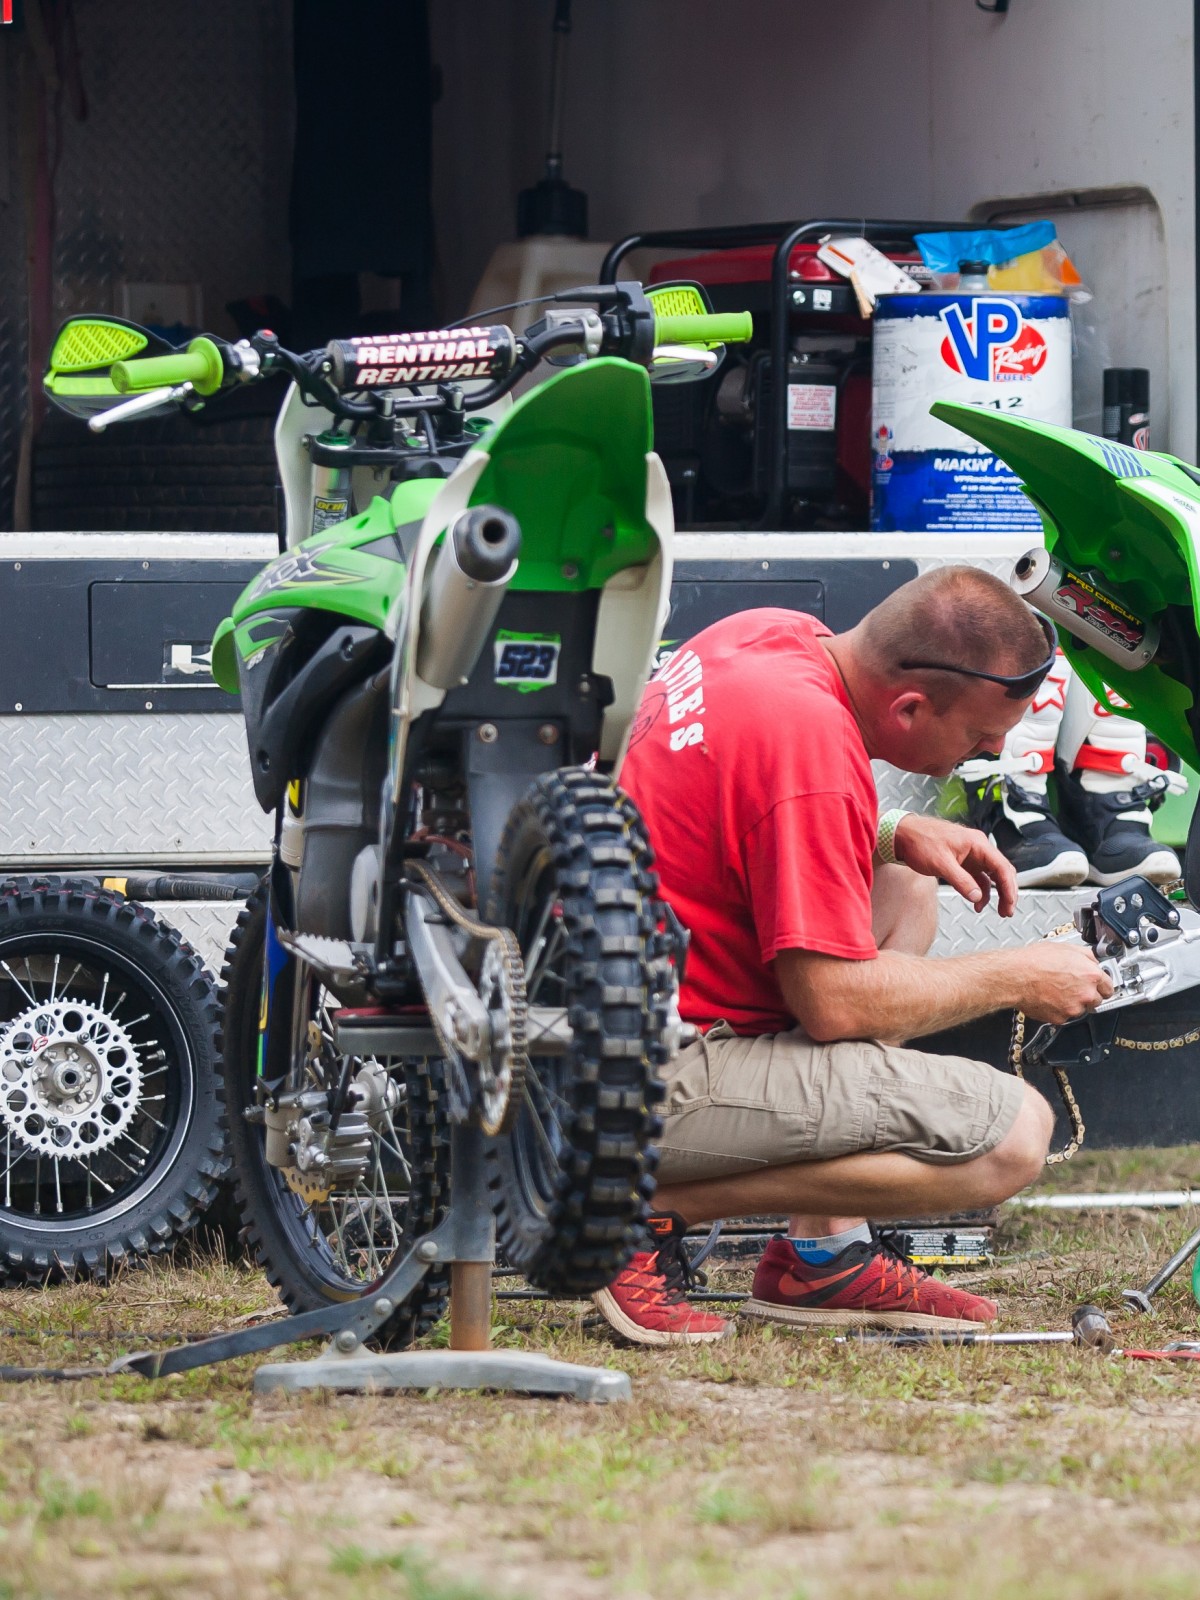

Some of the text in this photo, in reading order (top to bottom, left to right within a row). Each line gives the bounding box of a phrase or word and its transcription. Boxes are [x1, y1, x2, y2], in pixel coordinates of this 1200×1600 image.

[356, 338, 495, 365] RENTHAL
[940, 298, 1021, 381] VP
[993, 342, 1047, 373] Racing
[355, 361, 491, 386] RENTHAL
[996, 373, 1033, 382] FUELS
[933, 457, 994, 472] MAKIN'
[1067, 572, 1142, 626] PRO CIRCUIT
[497, 644, 557, 678] 523
